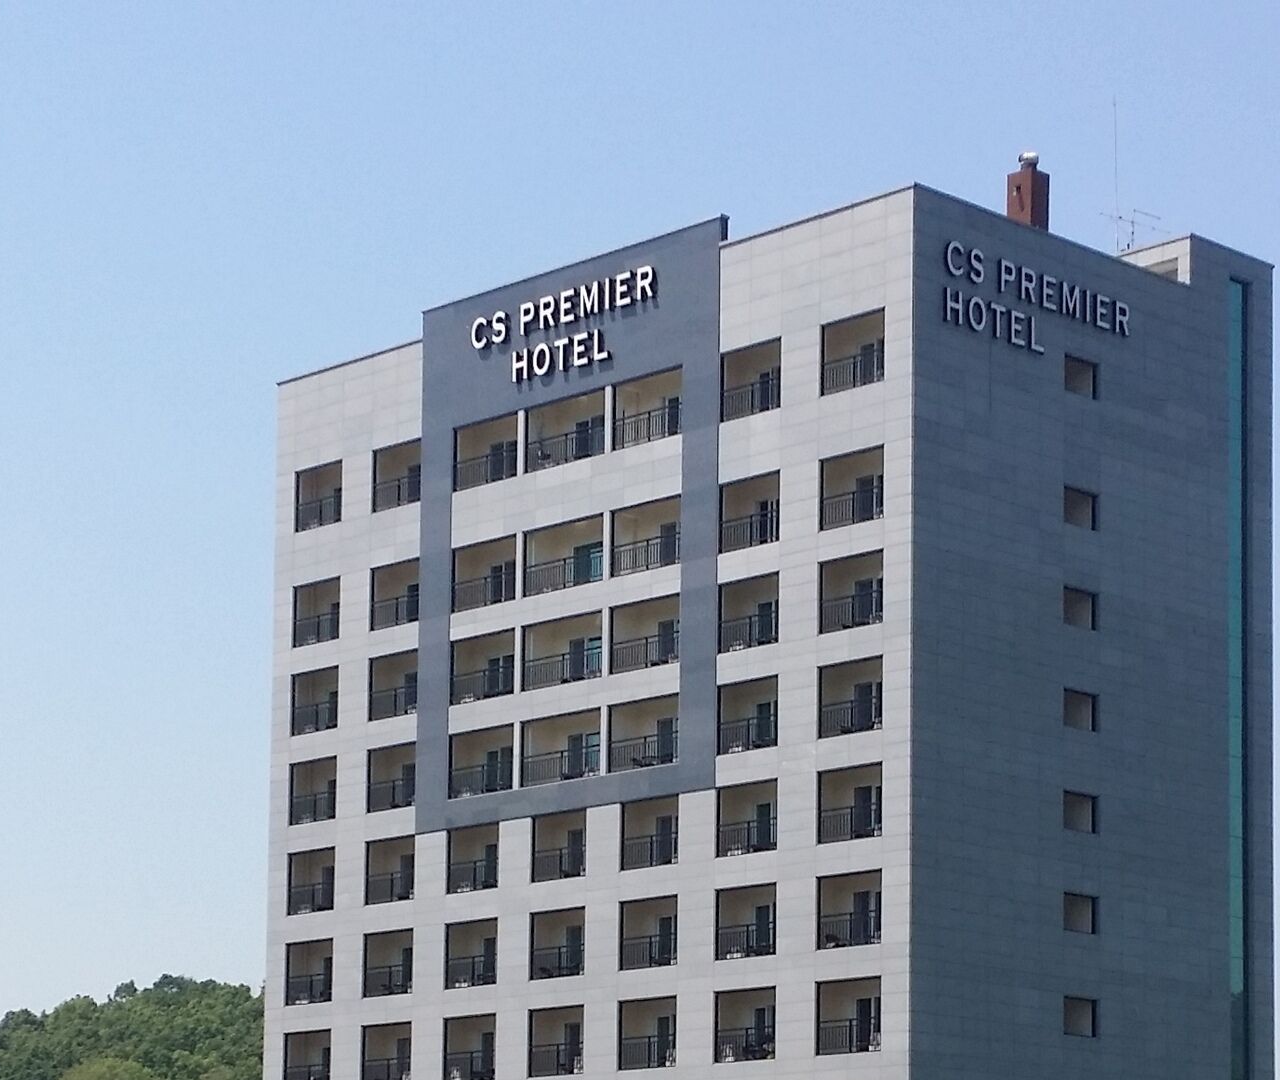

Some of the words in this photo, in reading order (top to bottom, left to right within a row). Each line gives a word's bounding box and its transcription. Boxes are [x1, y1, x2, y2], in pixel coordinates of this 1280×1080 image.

[471, 310, 506, 350] CS
[520, 265, 653, 336] PREMIER
[946, 240, 985, 284] CS
[1000, 258, 1130, 336] PREMIER
[946, 287, 1045, 353] HOTEL
[511, 328, 609, 383] HOTEL
